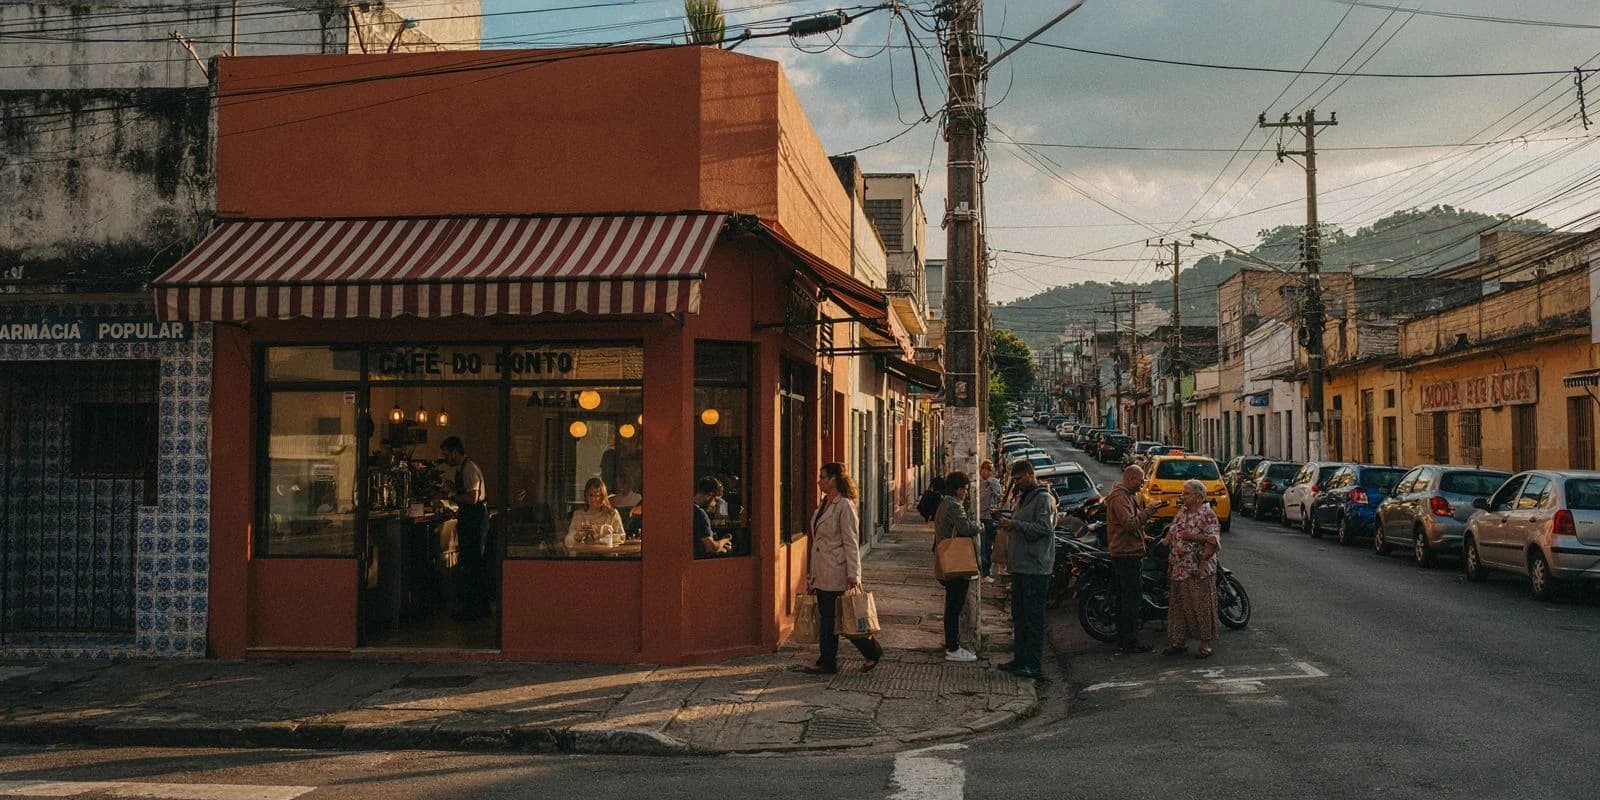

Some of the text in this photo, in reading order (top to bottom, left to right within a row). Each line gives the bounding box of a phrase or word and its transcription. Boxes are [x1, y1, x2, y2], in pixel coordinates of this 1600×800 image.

[0, 318, 184, 340] ARMÁCIA POPULAR
[379, 345, 440, 374] CAFÉ
[452, 352, 482, 374] DO
